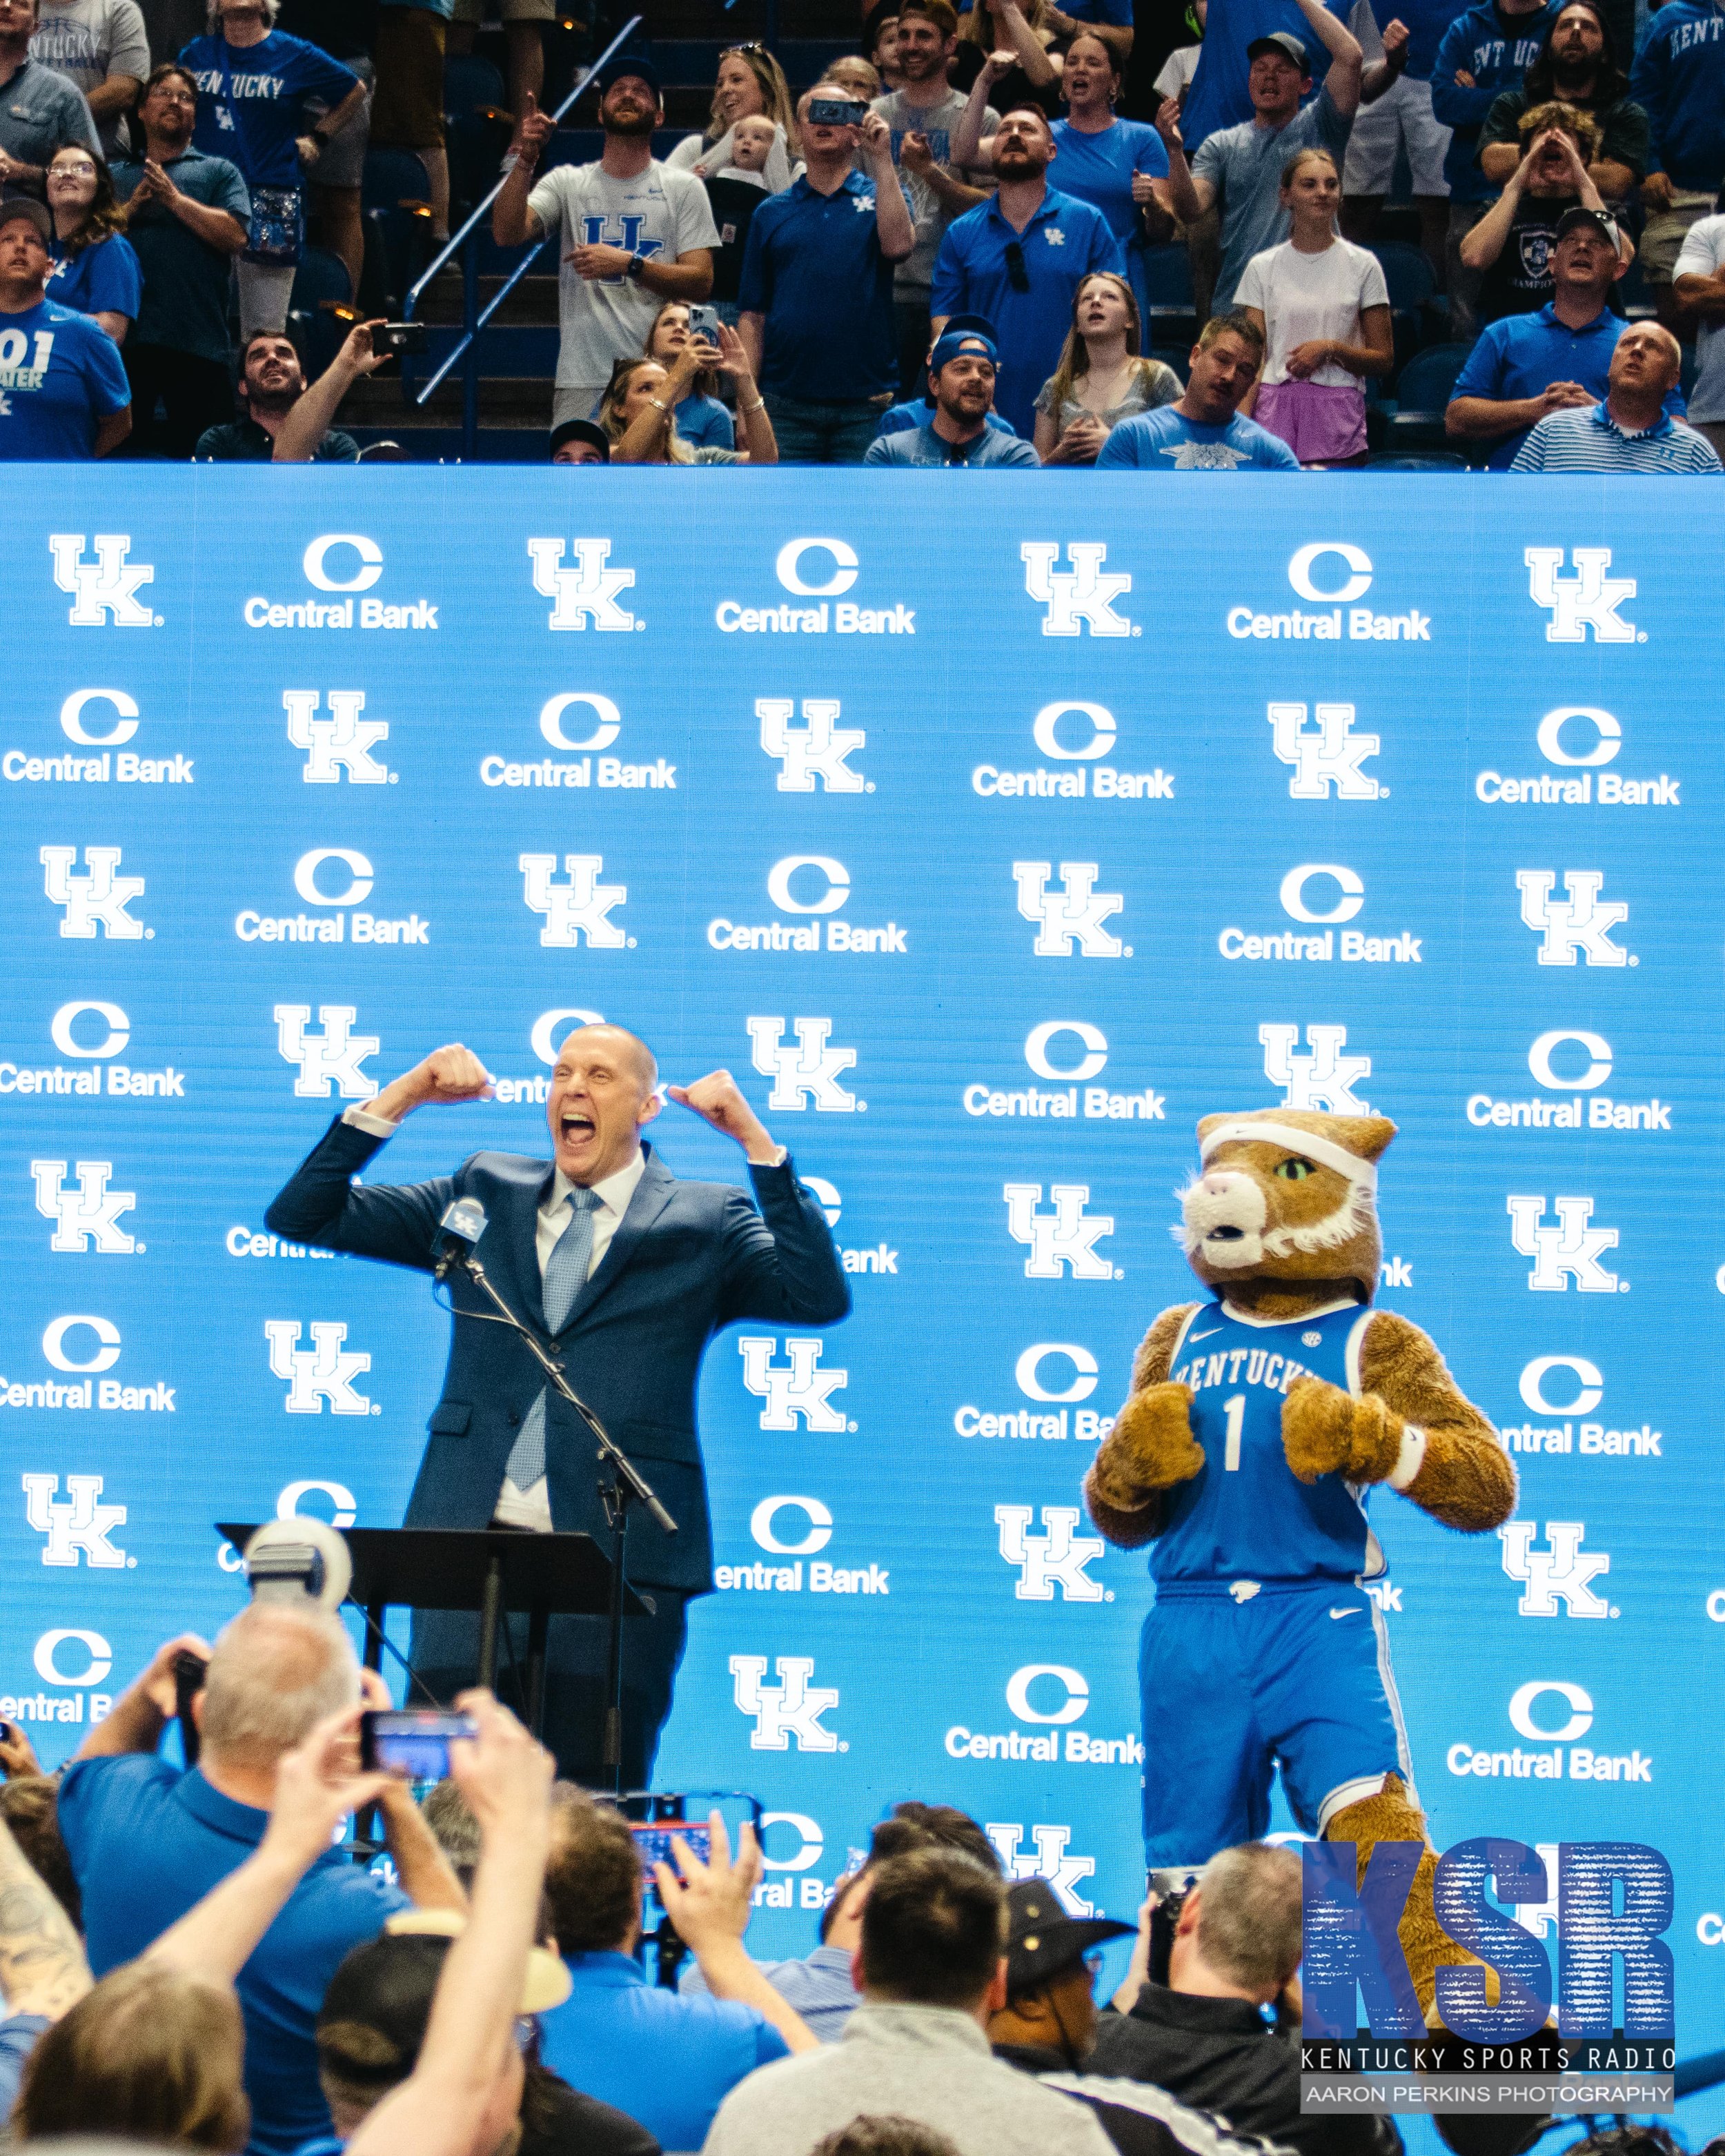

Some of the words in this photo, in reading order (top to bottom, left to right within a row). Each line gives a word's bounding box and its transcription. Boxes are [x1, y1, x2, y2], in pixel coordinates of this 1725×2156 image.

[28, 34, 101, 59] NTUCKY
[194, 70, 284, 99] ENUCKY
[49, 534, 154, 626] UK
[527, 537, 635, 631] UK
[1021, 542, 1132, 637] UK
[1524, 547, 1637, 642] UK
[244, 597, 353, 628] Central
[360, 599, 438, 629] Bank
[716, 601, 828, 633] Central
[836, 602, 915, 633] Bank
[1228, 606, 1341, 639] Central
[1349, 609, 1430, 640] Bank
[283, 690, 388, 784] UK
[755, 698, 876, 793] UK
[1268, 702, 1380, 800] UK
[3, 751, 110, 782] Central
[116, 753, 194, 782] Bank
[480, 756, 591, 787] Central
[597, 758, 676, 788] Bank
[972, 765, 1085, 797] Central
[1093, 767, 1174, 798] Bank
[1476, 771, 1591, 804] Central
[1597, 773, 1679, 804] Bank
[40, 846, 145, 939] UK
[518, 853, 627, 948] UK
[1012, 861, 1123, 958] UK
[235, 911, 344, 942] Central
[352, 913, 428, 944] Bank
[708, 919, 820, 951] Central
[827, 921, 907, 952] Bank
[1516, 870, 1628, 967] UK
[1219, 928, 1333, 960] Central
[1341, 931, 1421, 962] Bank
[274, 1005, 380, 1098] UK
[747, 1016, 856, 1112] UK
[108, 1066, 184, 1096] Bank
[963, 1085, 1077, 1117] Central
[1084, 1087, 1165, 1119] Bank
[1467, 1094, 1581, 1127] Central
[1589, 1098, 1671, 1129] Bank
[30, 1160, 136, 1254] UK
[1003, 1183, 1114, 1280] UK
[1507, 1195, 1619, 1293] UK
[841, 1244, 898, 1274] ank
[265, 1321, 371, 1415] UK
[739, 1337, 847, 1432] UK
[1176, 1347, 1323, 1395] ENTUCK
[99, 1381, 175, 1412] Bank
[955, 1406, 1067, 1439] Central
[1075, 1410, 1114, 1441] Ba
[1223, 1394, 1246, 1472] 1
[1501, 1424, 1572, 1454] ntral
[1579, 1424, 1659, 1456] Bank
[22, 1474, 126, 1568] UK
[994, 1505, 1105, 1601] UK
[1497, 1521, 1609, 1618] UK
[716, 1562, 802, 1591] entral
[810, 1562, 889, 1594] Bank
[1, 1693, 83, 1723] entral
[729, 1656, 838, 1752] UK
[945, 1727, 1058, 1761] Central
[1065, 1732, 1141, 1764] Bank
[1447, 1744, 1562, 1779] Central
[1569, 1748, 1652, 1781] Bank
